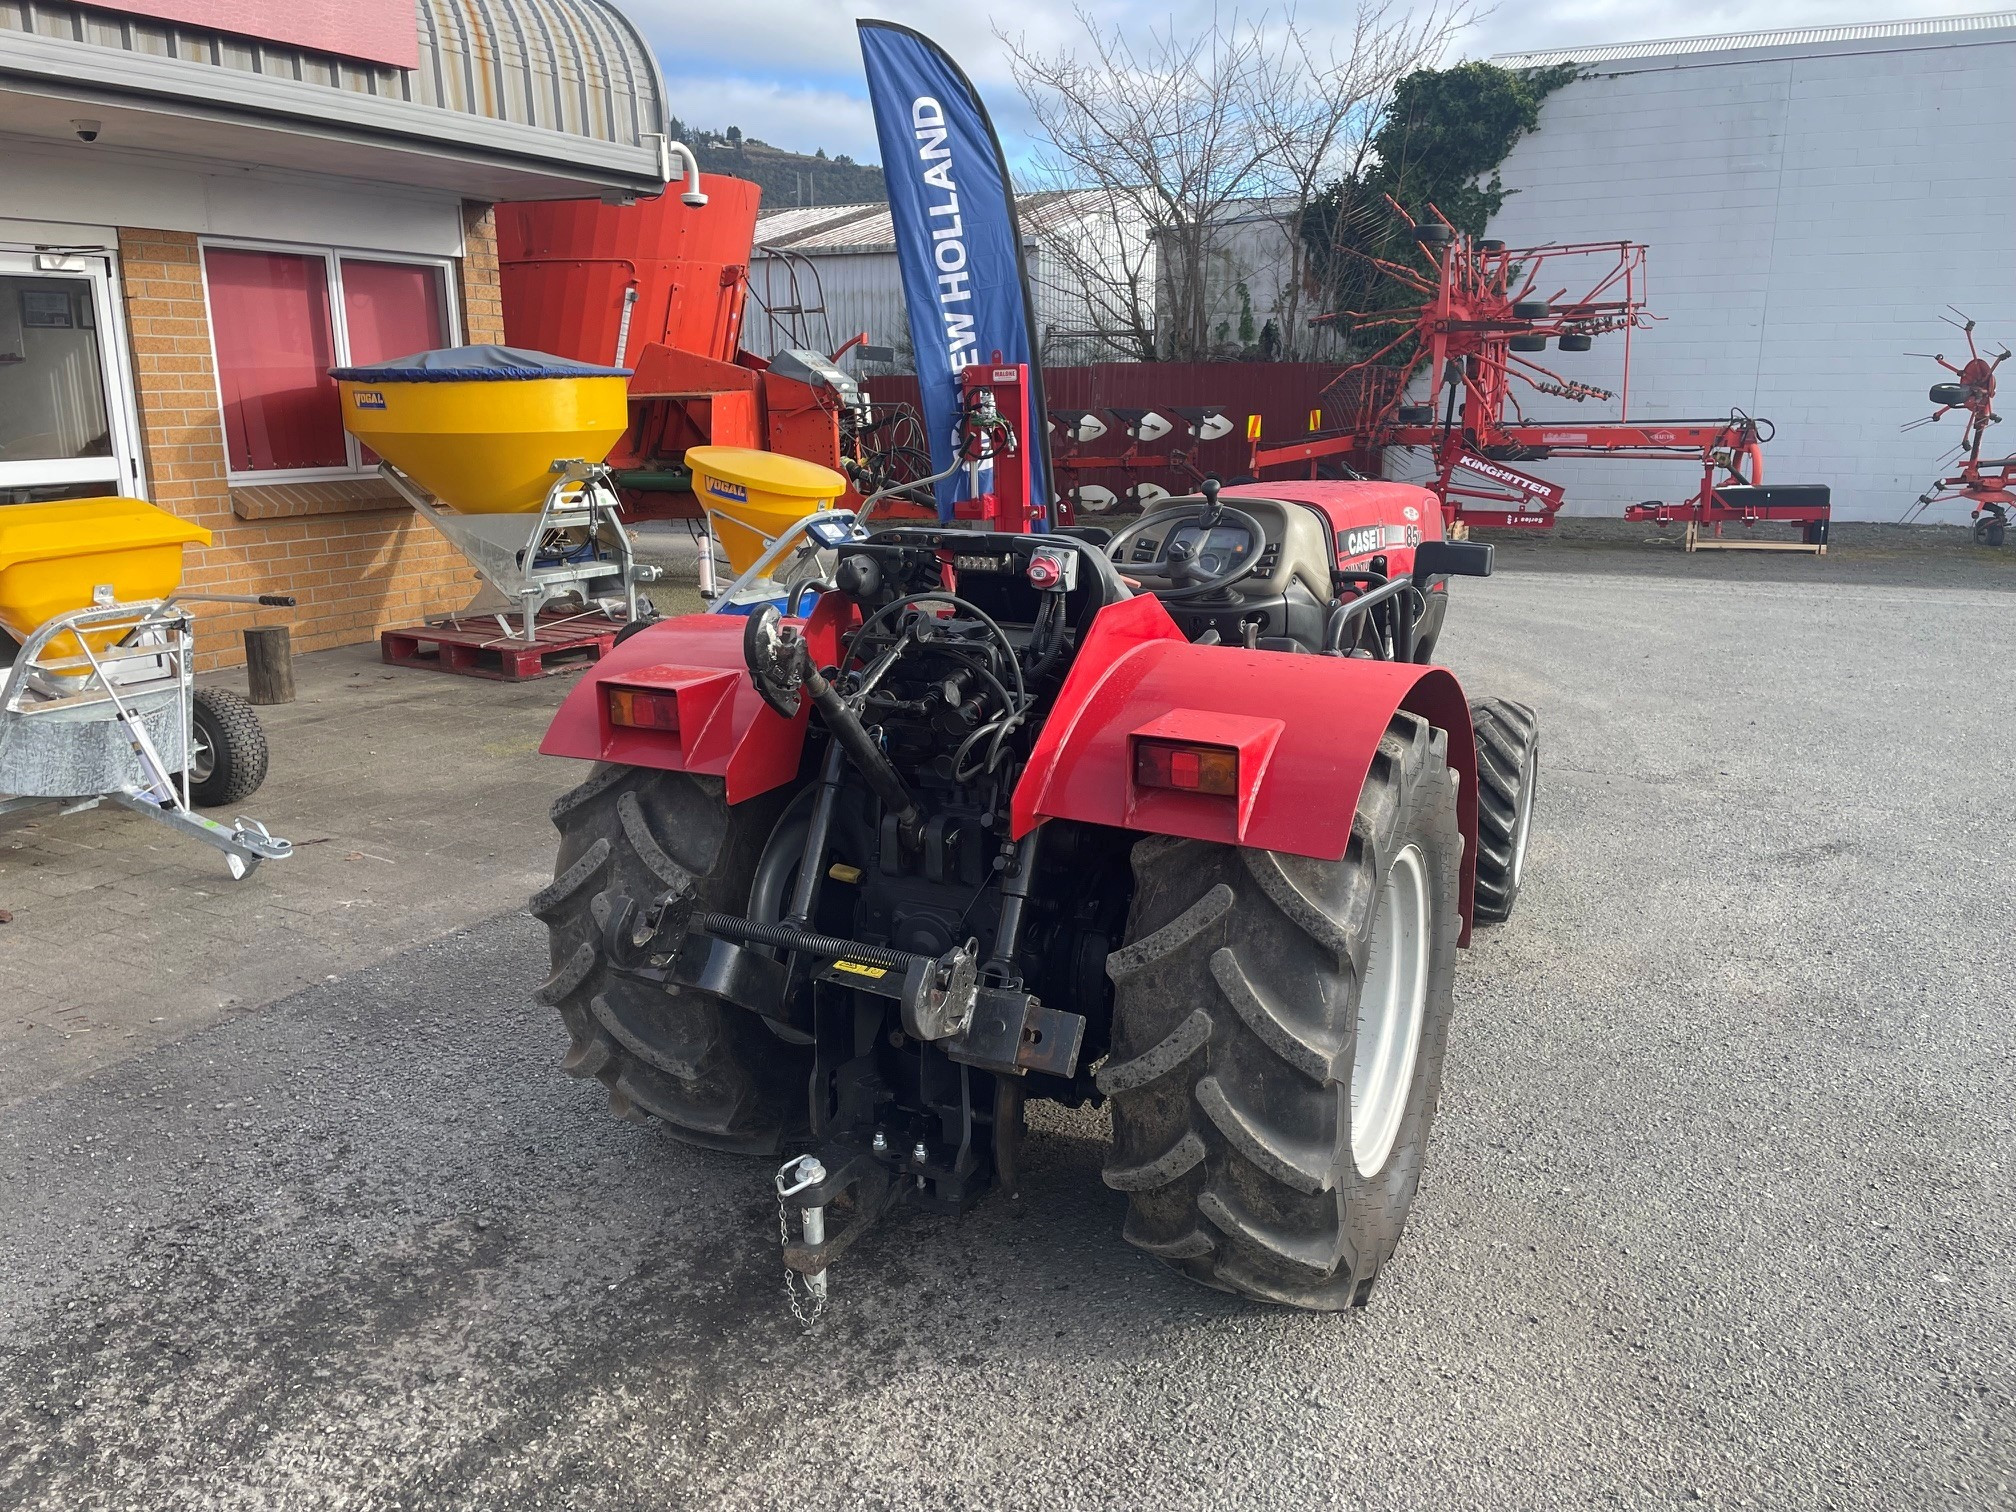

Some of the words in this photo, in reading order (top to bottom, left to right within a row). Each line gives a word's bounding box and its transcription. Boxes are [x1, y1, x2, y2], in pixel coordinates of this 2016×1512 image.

[912, 96, 972, 303] HOLLAND
[354, 393, 384, 407] VOGAL
[705, 476, 746, 497] VOGAL
